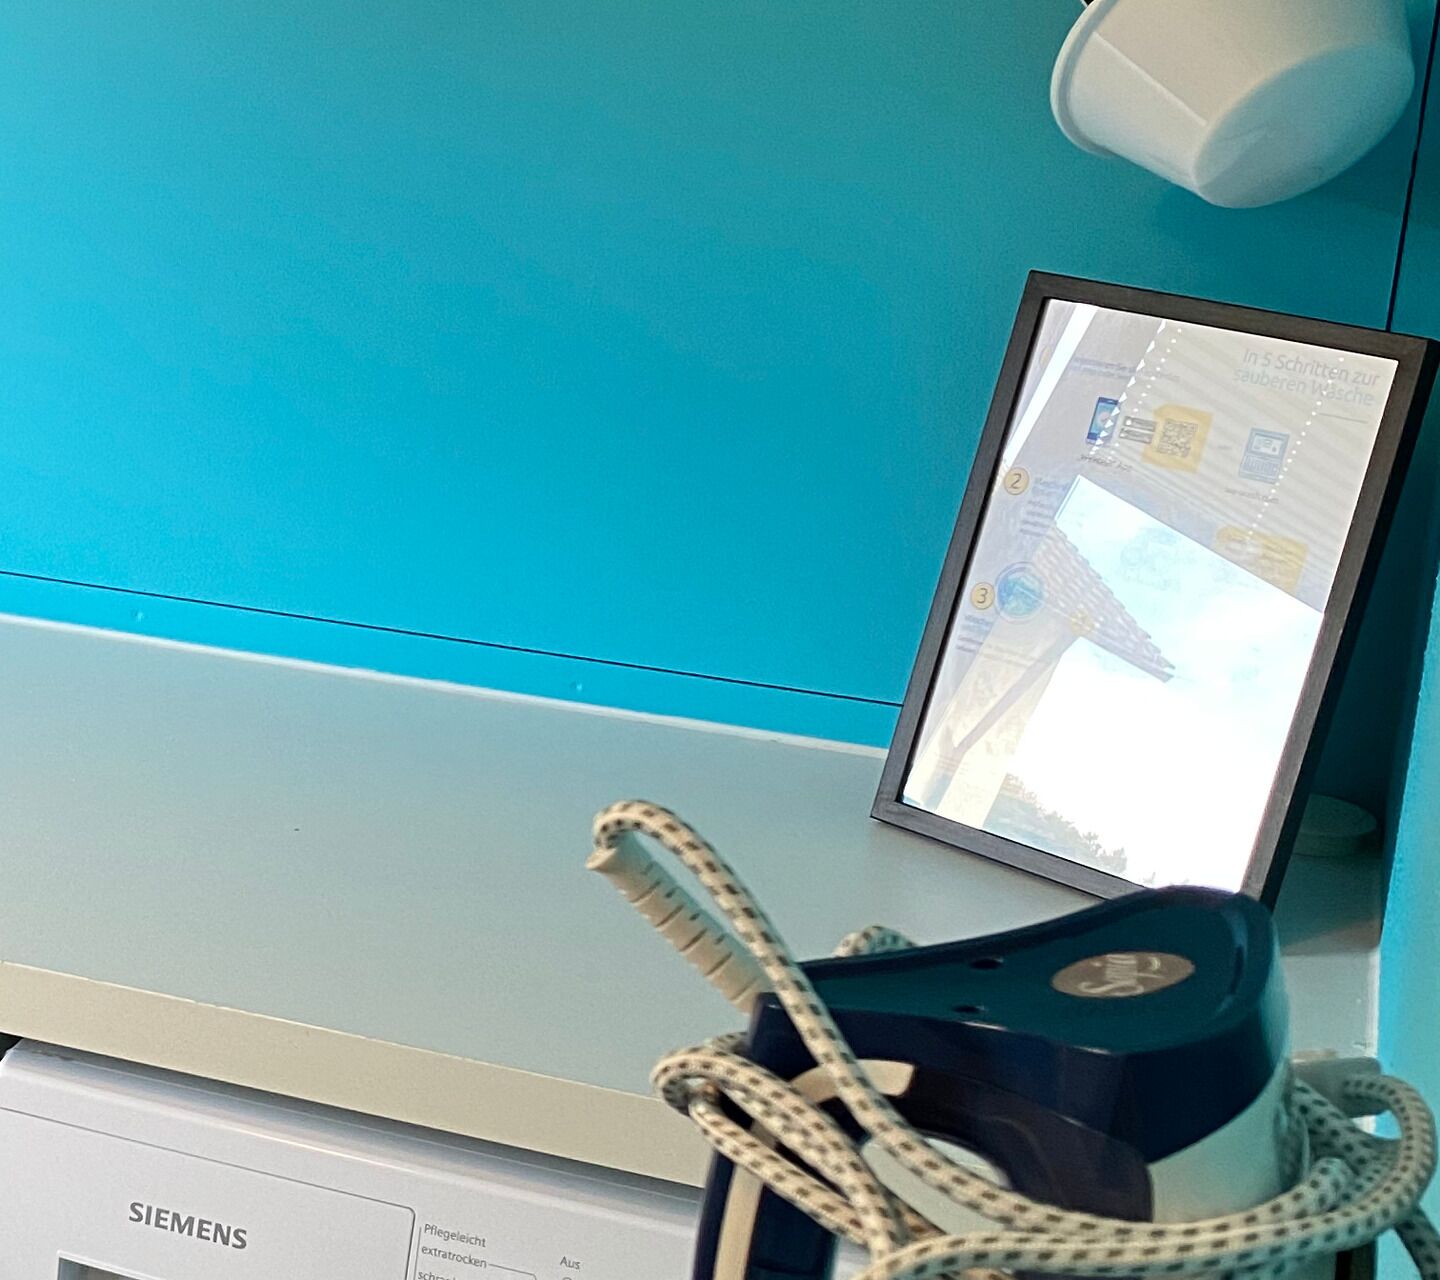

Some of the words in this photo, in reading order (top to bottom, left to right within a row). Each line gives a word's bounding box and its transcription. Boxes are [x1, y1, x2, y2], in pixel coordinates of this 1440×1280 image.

[1243, 348, 1257, 365] In
[1261, 351, 1272, 367] 5
[1274, 354, 1350, 380] Schritten
[1351, 370, 1380, 387] zur
[1233, 368, 1306, 395] sauberen
[1007, 472, 1023, 490] 2
[976, 587, 989, 604] 3
[128, 1201, 248, 1250] SIEMENS
[424, 1223, 488, 1248] Pflegeleicht
[421, 1245, 488, 1269] extratrocken
[560, 1256, 581, 1271] Aus
